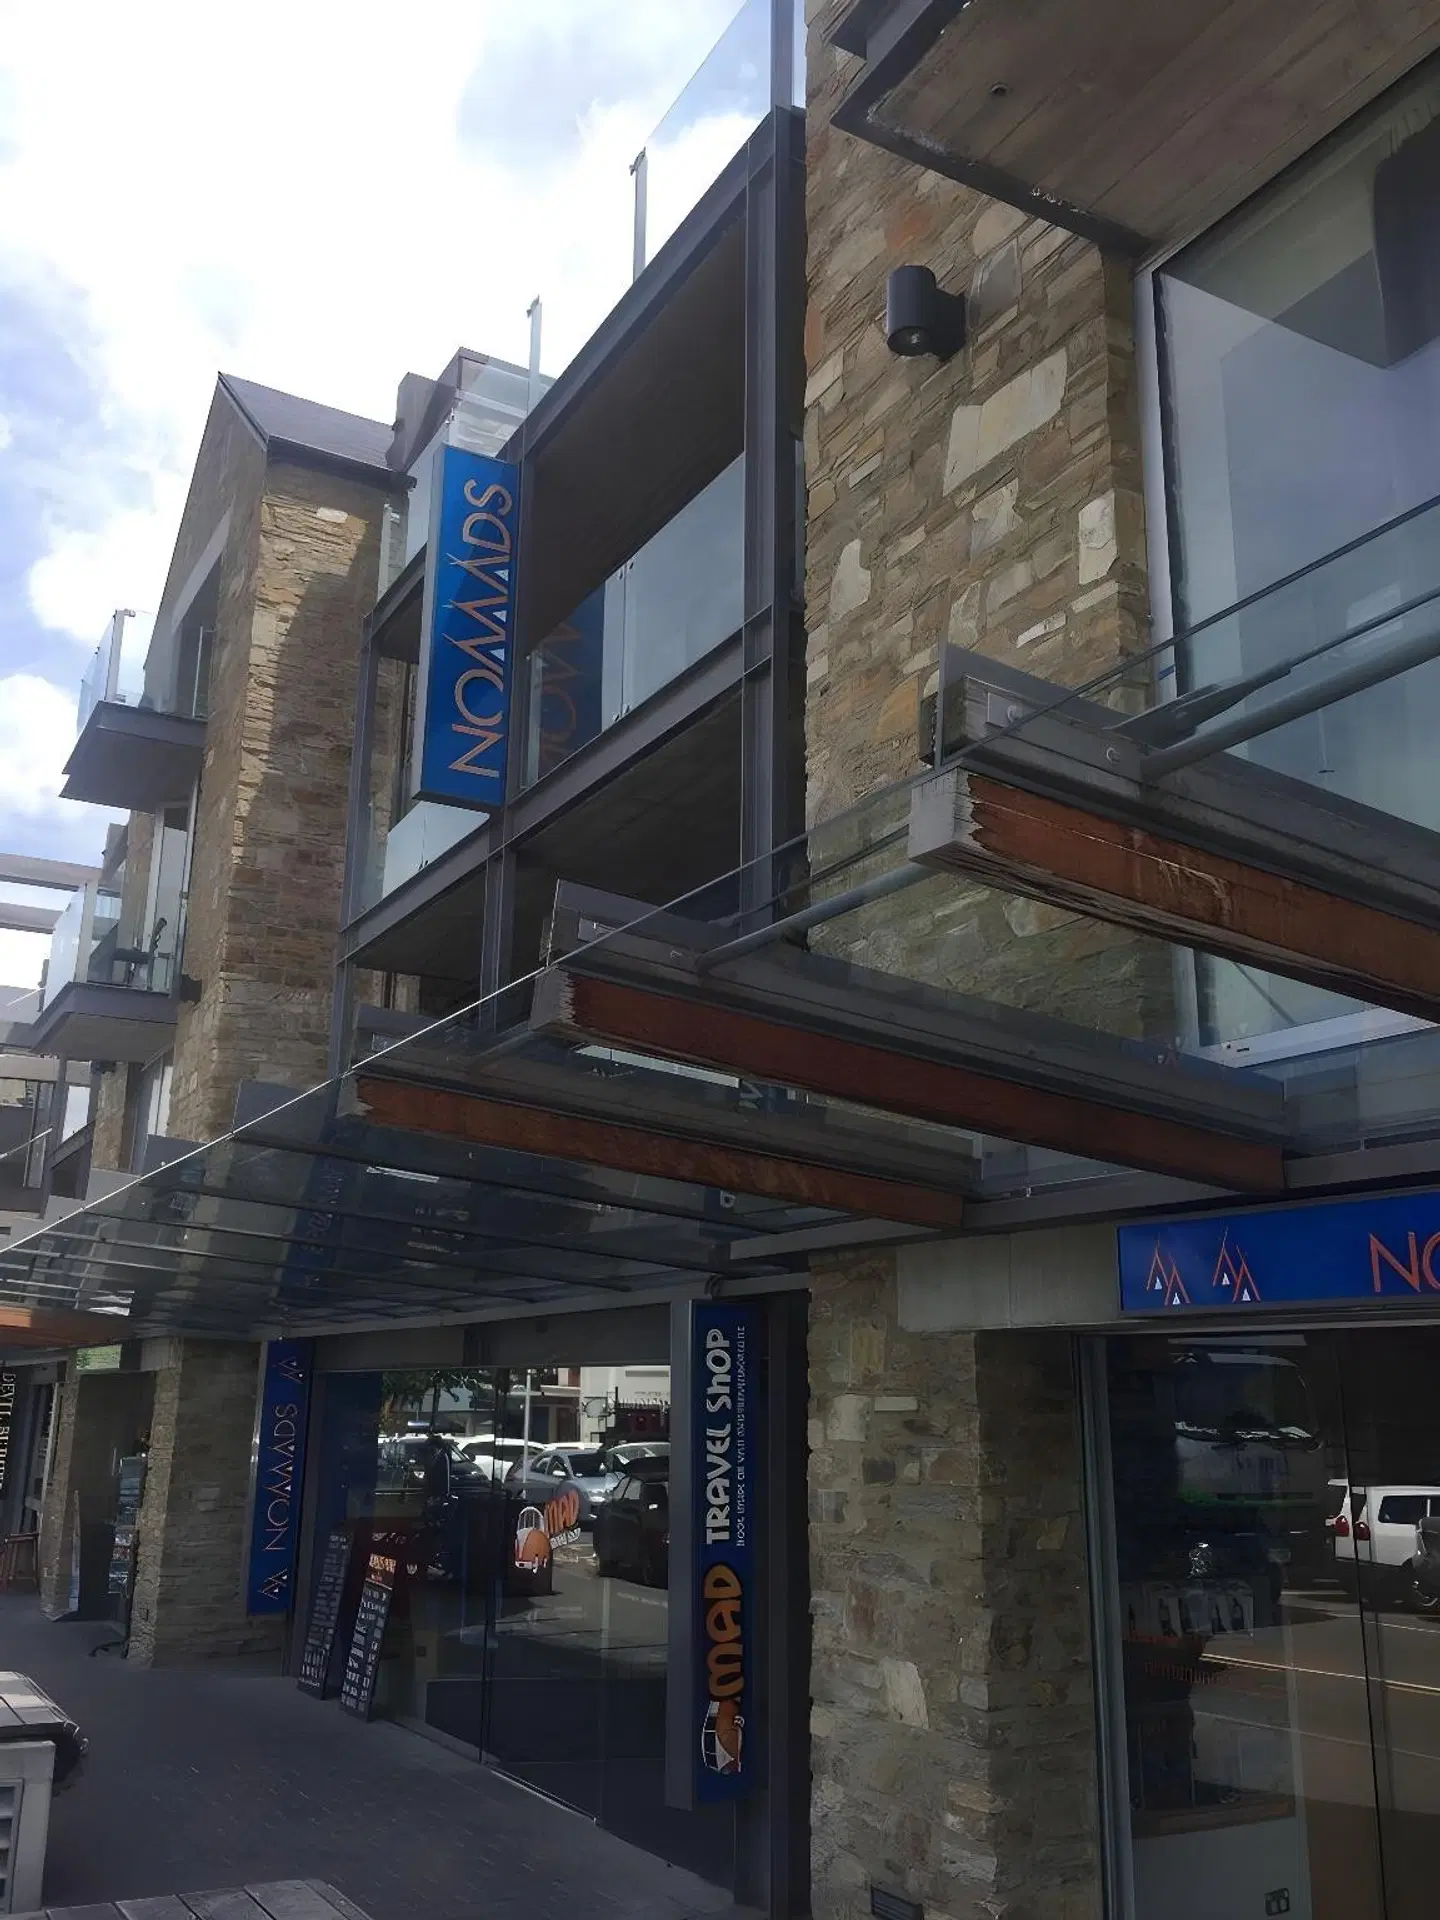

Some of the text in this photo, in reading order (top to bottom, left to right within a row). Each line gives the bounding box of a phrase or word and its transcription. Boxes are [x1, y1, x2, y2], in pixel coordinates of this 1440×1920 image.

[442, 478, 512, 779] NOMADS
[1368, 1231, 1440, 1293] N
[263, 1402, 299, 1551] NOMADS
[706, 1423, 732, 1545] TRAVEL
